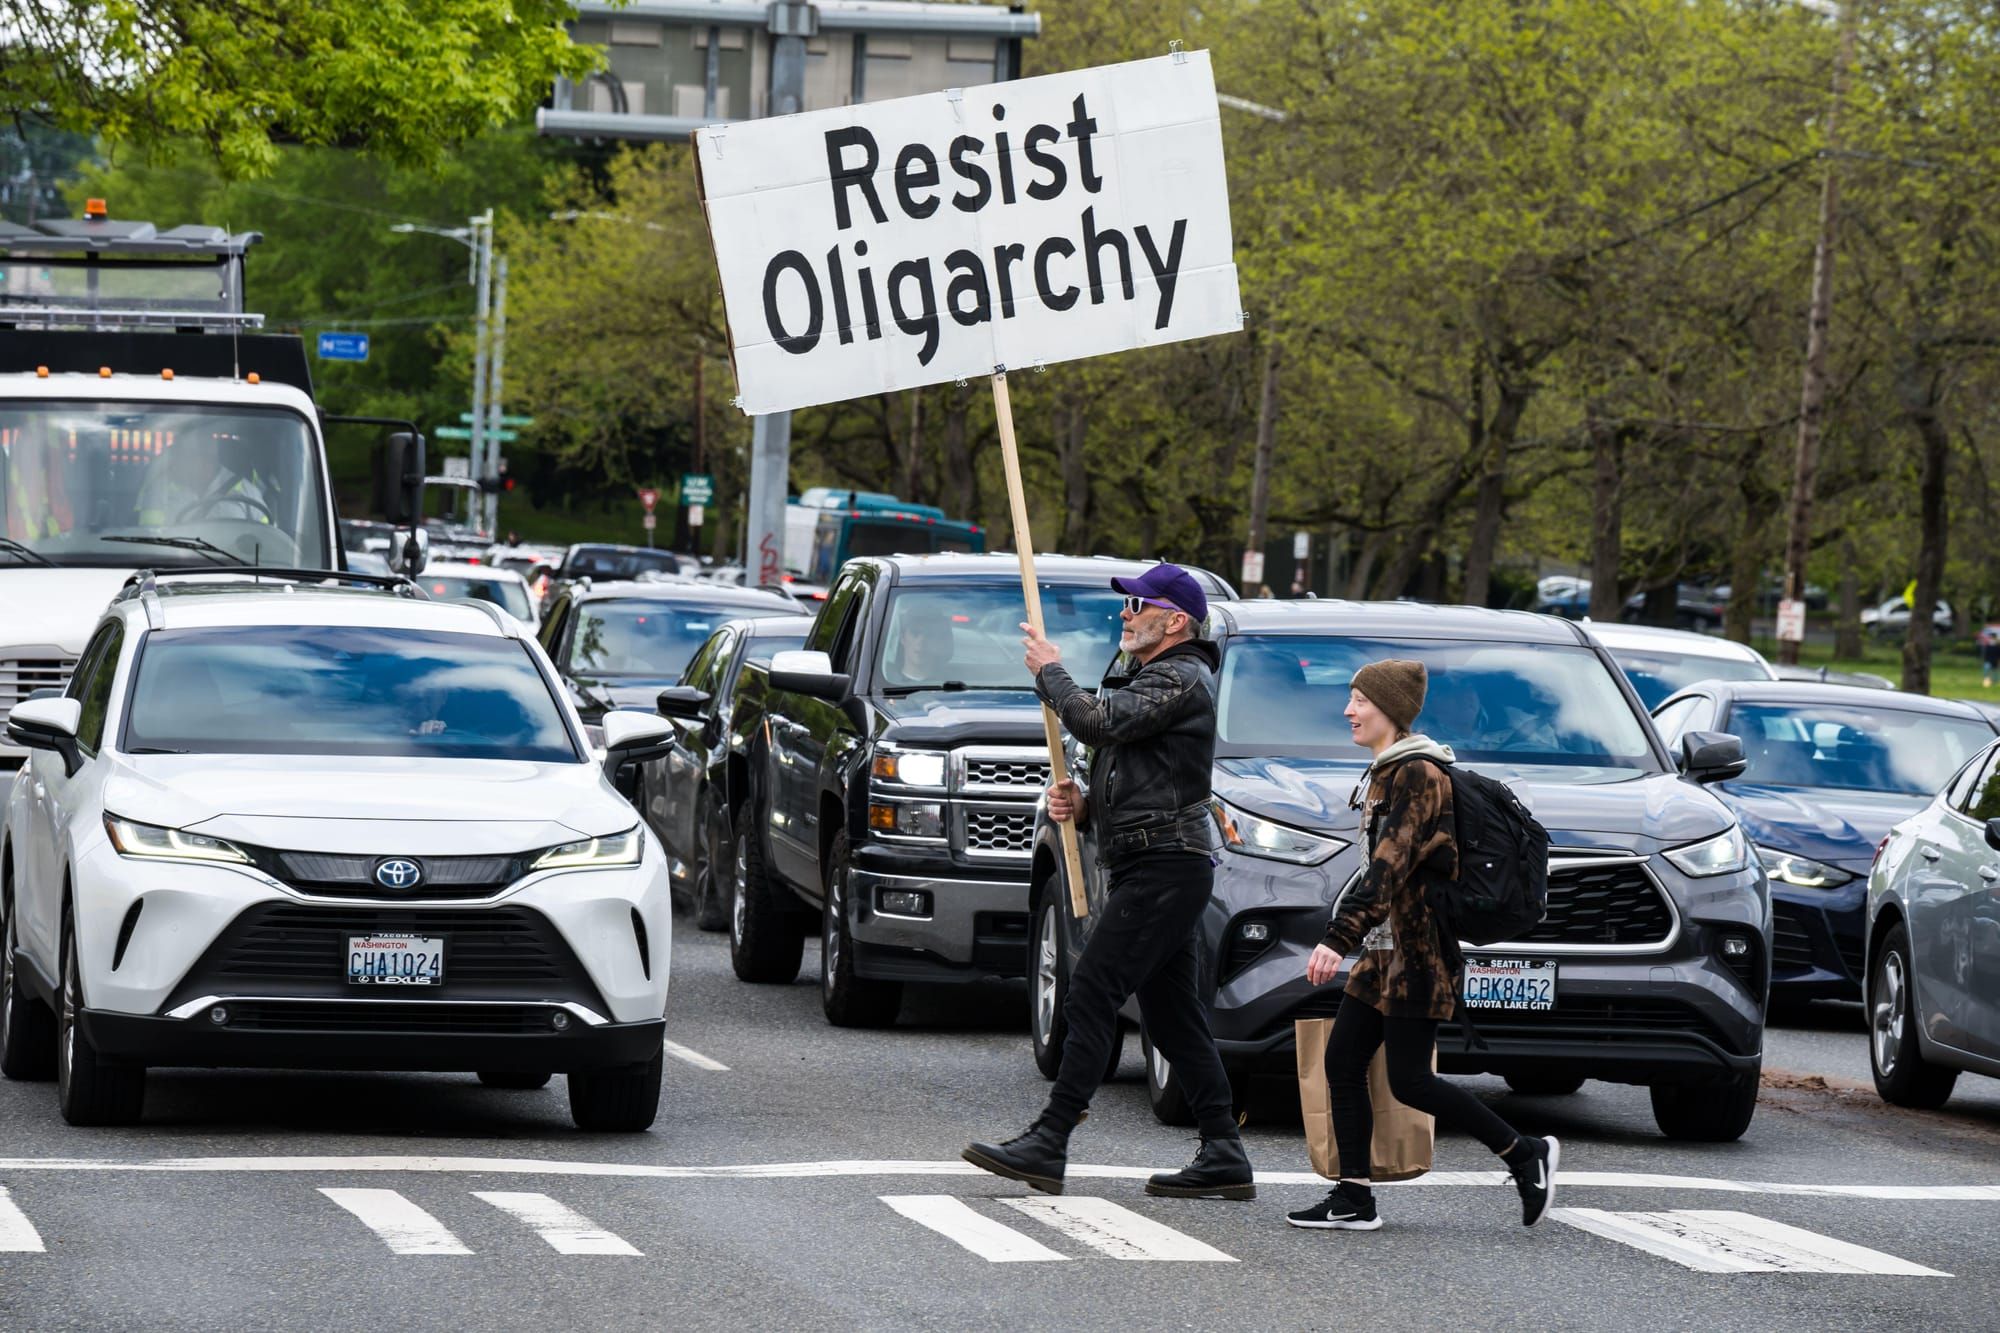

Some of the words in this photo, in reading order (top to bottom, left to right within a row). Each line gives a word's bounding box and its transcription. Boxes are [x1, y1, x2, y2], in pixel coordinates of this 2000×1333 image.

[824, 92, 1102, 230] Resist
[762, 205, 1188, 366] Oligarchy
[351, 952, 440, 976] CHA1024
[1469, 967, 1521, 975] WASHINGTON
[1490, 960, 1531, 968] SEATTLE
[375, 976, 431, 984] LEXUS
[1467, 977, 1550, 1002] CBK8452
[1465, 1000, 1502, 1008] TOYOTA
[1504, 1001, 1528, 1009] LAKE
[1530, 1001, 1553, 1010] CITY
